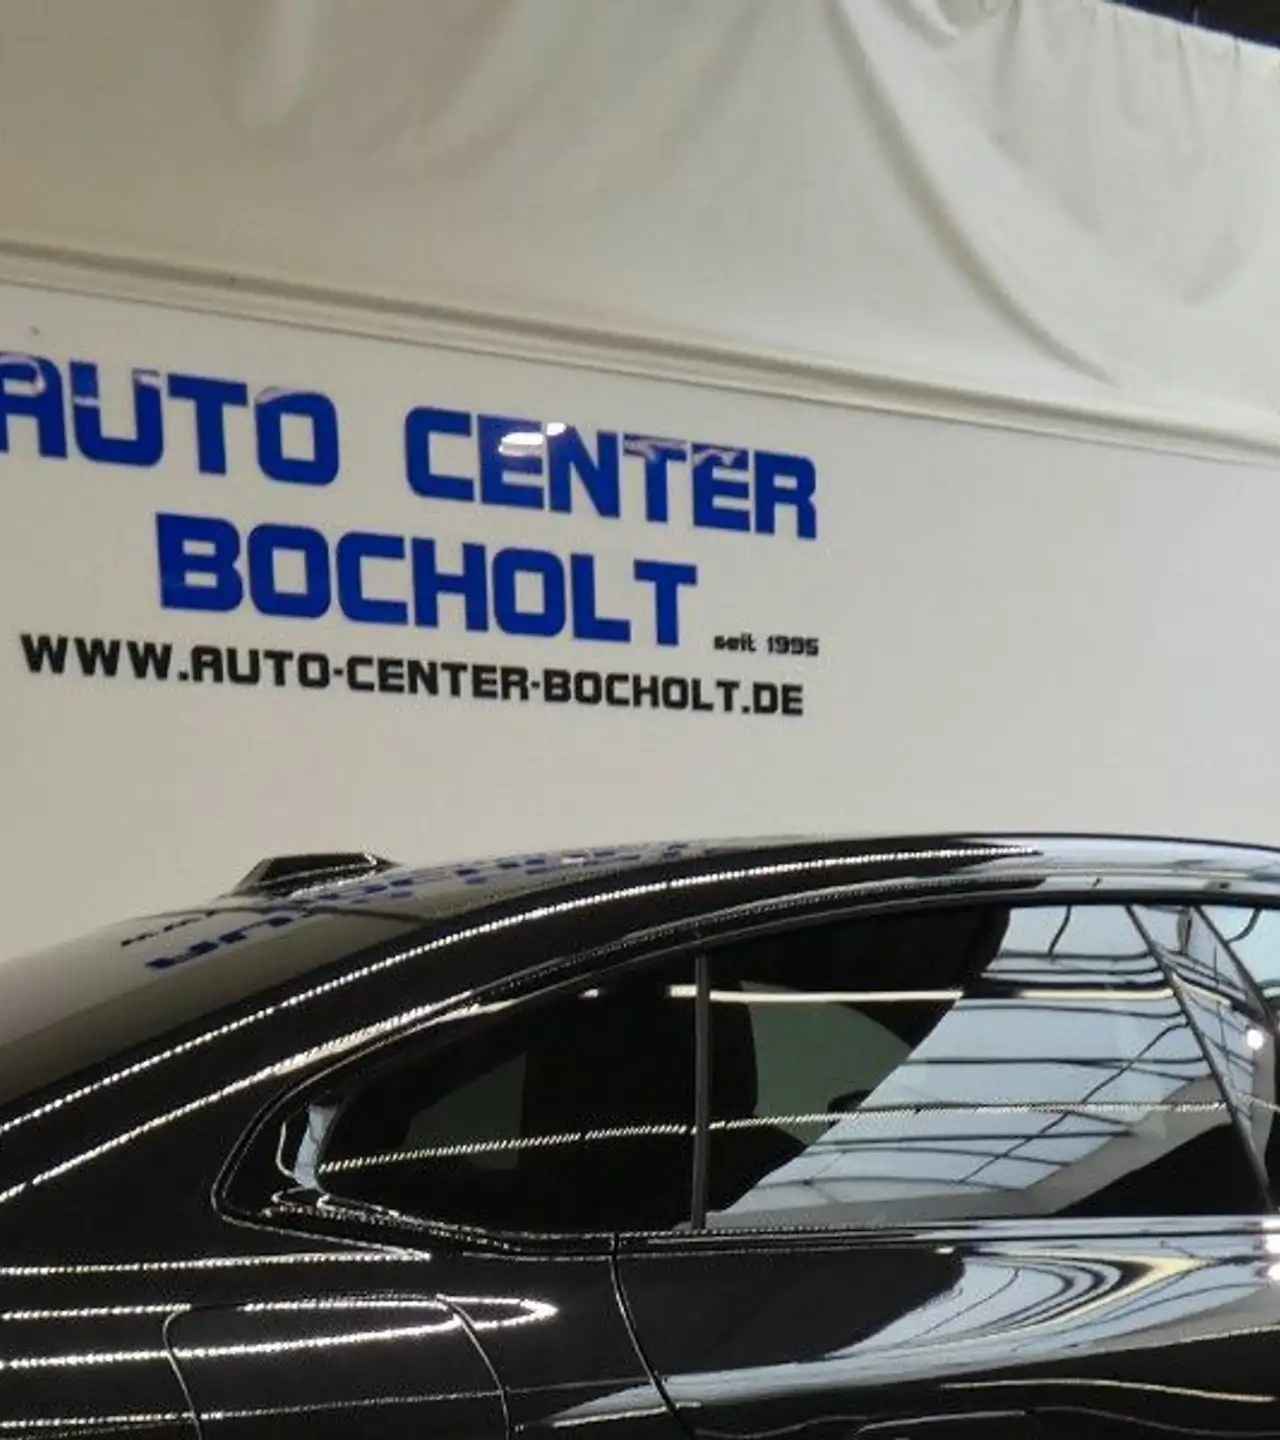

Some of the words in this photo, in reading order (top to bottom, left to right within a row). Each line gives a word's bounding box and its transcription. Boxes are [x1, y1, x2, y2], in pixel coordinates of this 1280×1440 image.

[404, 408, 816, 539] CENTER
[156, 512, 697, 646] BOCHOLT
[21, 634, 804, 716] WWW.AUTO-CENTER-BOCHOLT.DE
[713, 632, 756, 652] seit
[767, 634, 819, 656] 1995
